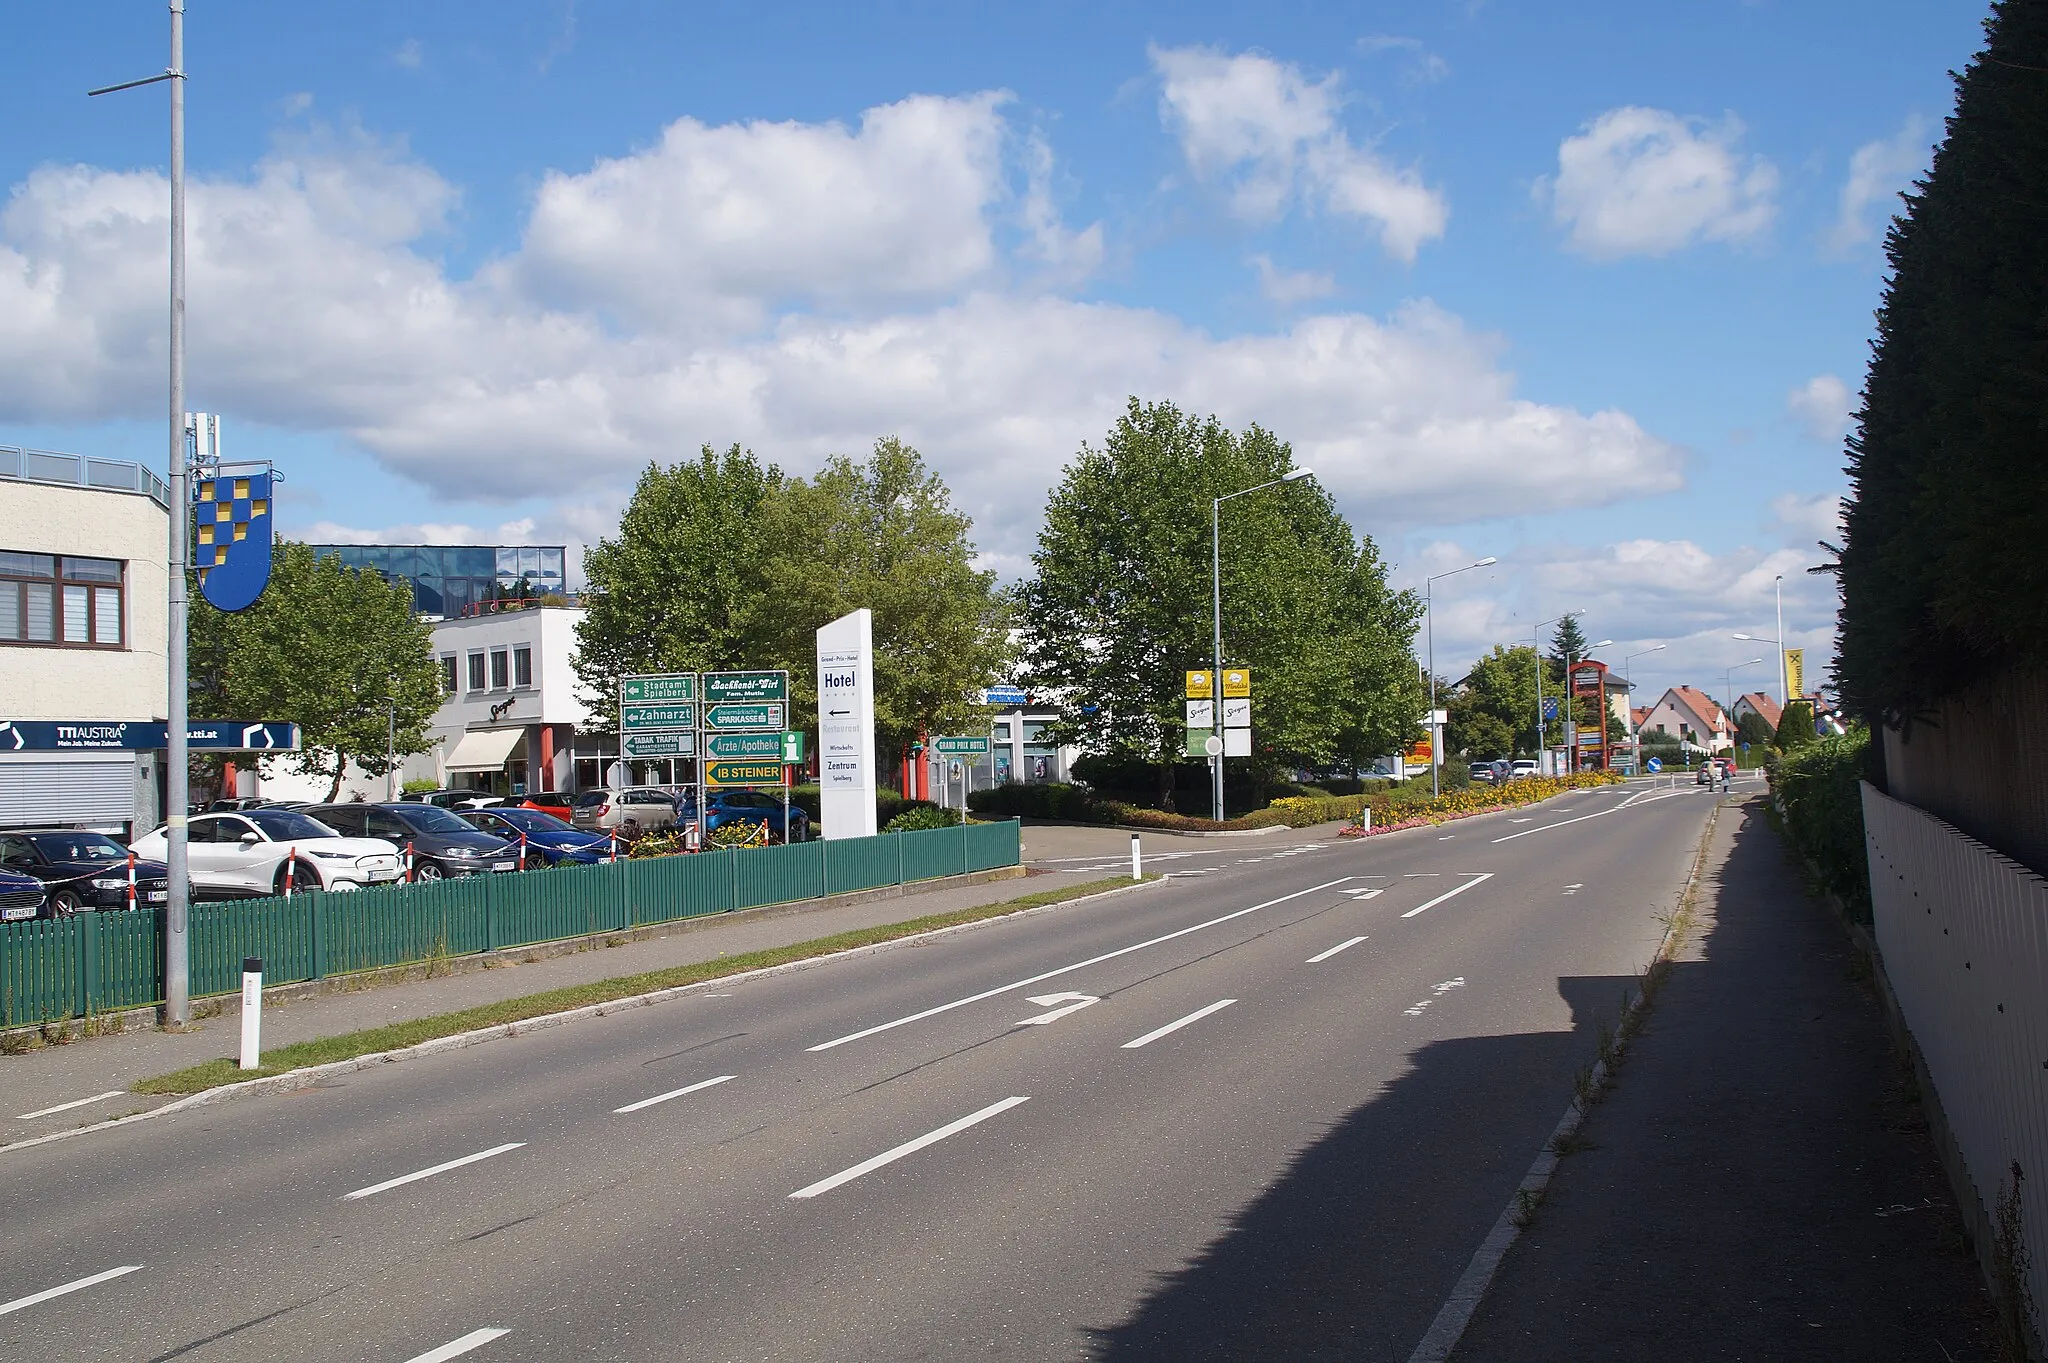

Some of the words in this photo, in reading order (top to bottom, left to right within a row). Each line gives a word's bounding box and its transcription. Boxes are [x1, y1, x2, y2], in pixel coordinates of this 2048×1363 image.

[825, 671, 855, 688] Hotel
[643, 681, 686, 690] Stadtamt
[643, 689, 687, 698] Spielberg
[639, 708, 691, 720] Zahnarzt
[717, 715, 758, 724] SPARKASSE
[822, 724, 860, 733] Restaurant
[164, 730, 218, 739] .tti.at
[633, 736, 654, 744] TABAK
[655, 735, 679, 743] TRAFIK
[940, 741, 956, 750] GRAND
[956, 741, 969, 750] PRIX
[969, 741, 985, 750] HOTEL
[827, 761, 857, 770] Zentrum
[717, 768, 729, 778] IB
[731, 767, 779, 778] STEINER
